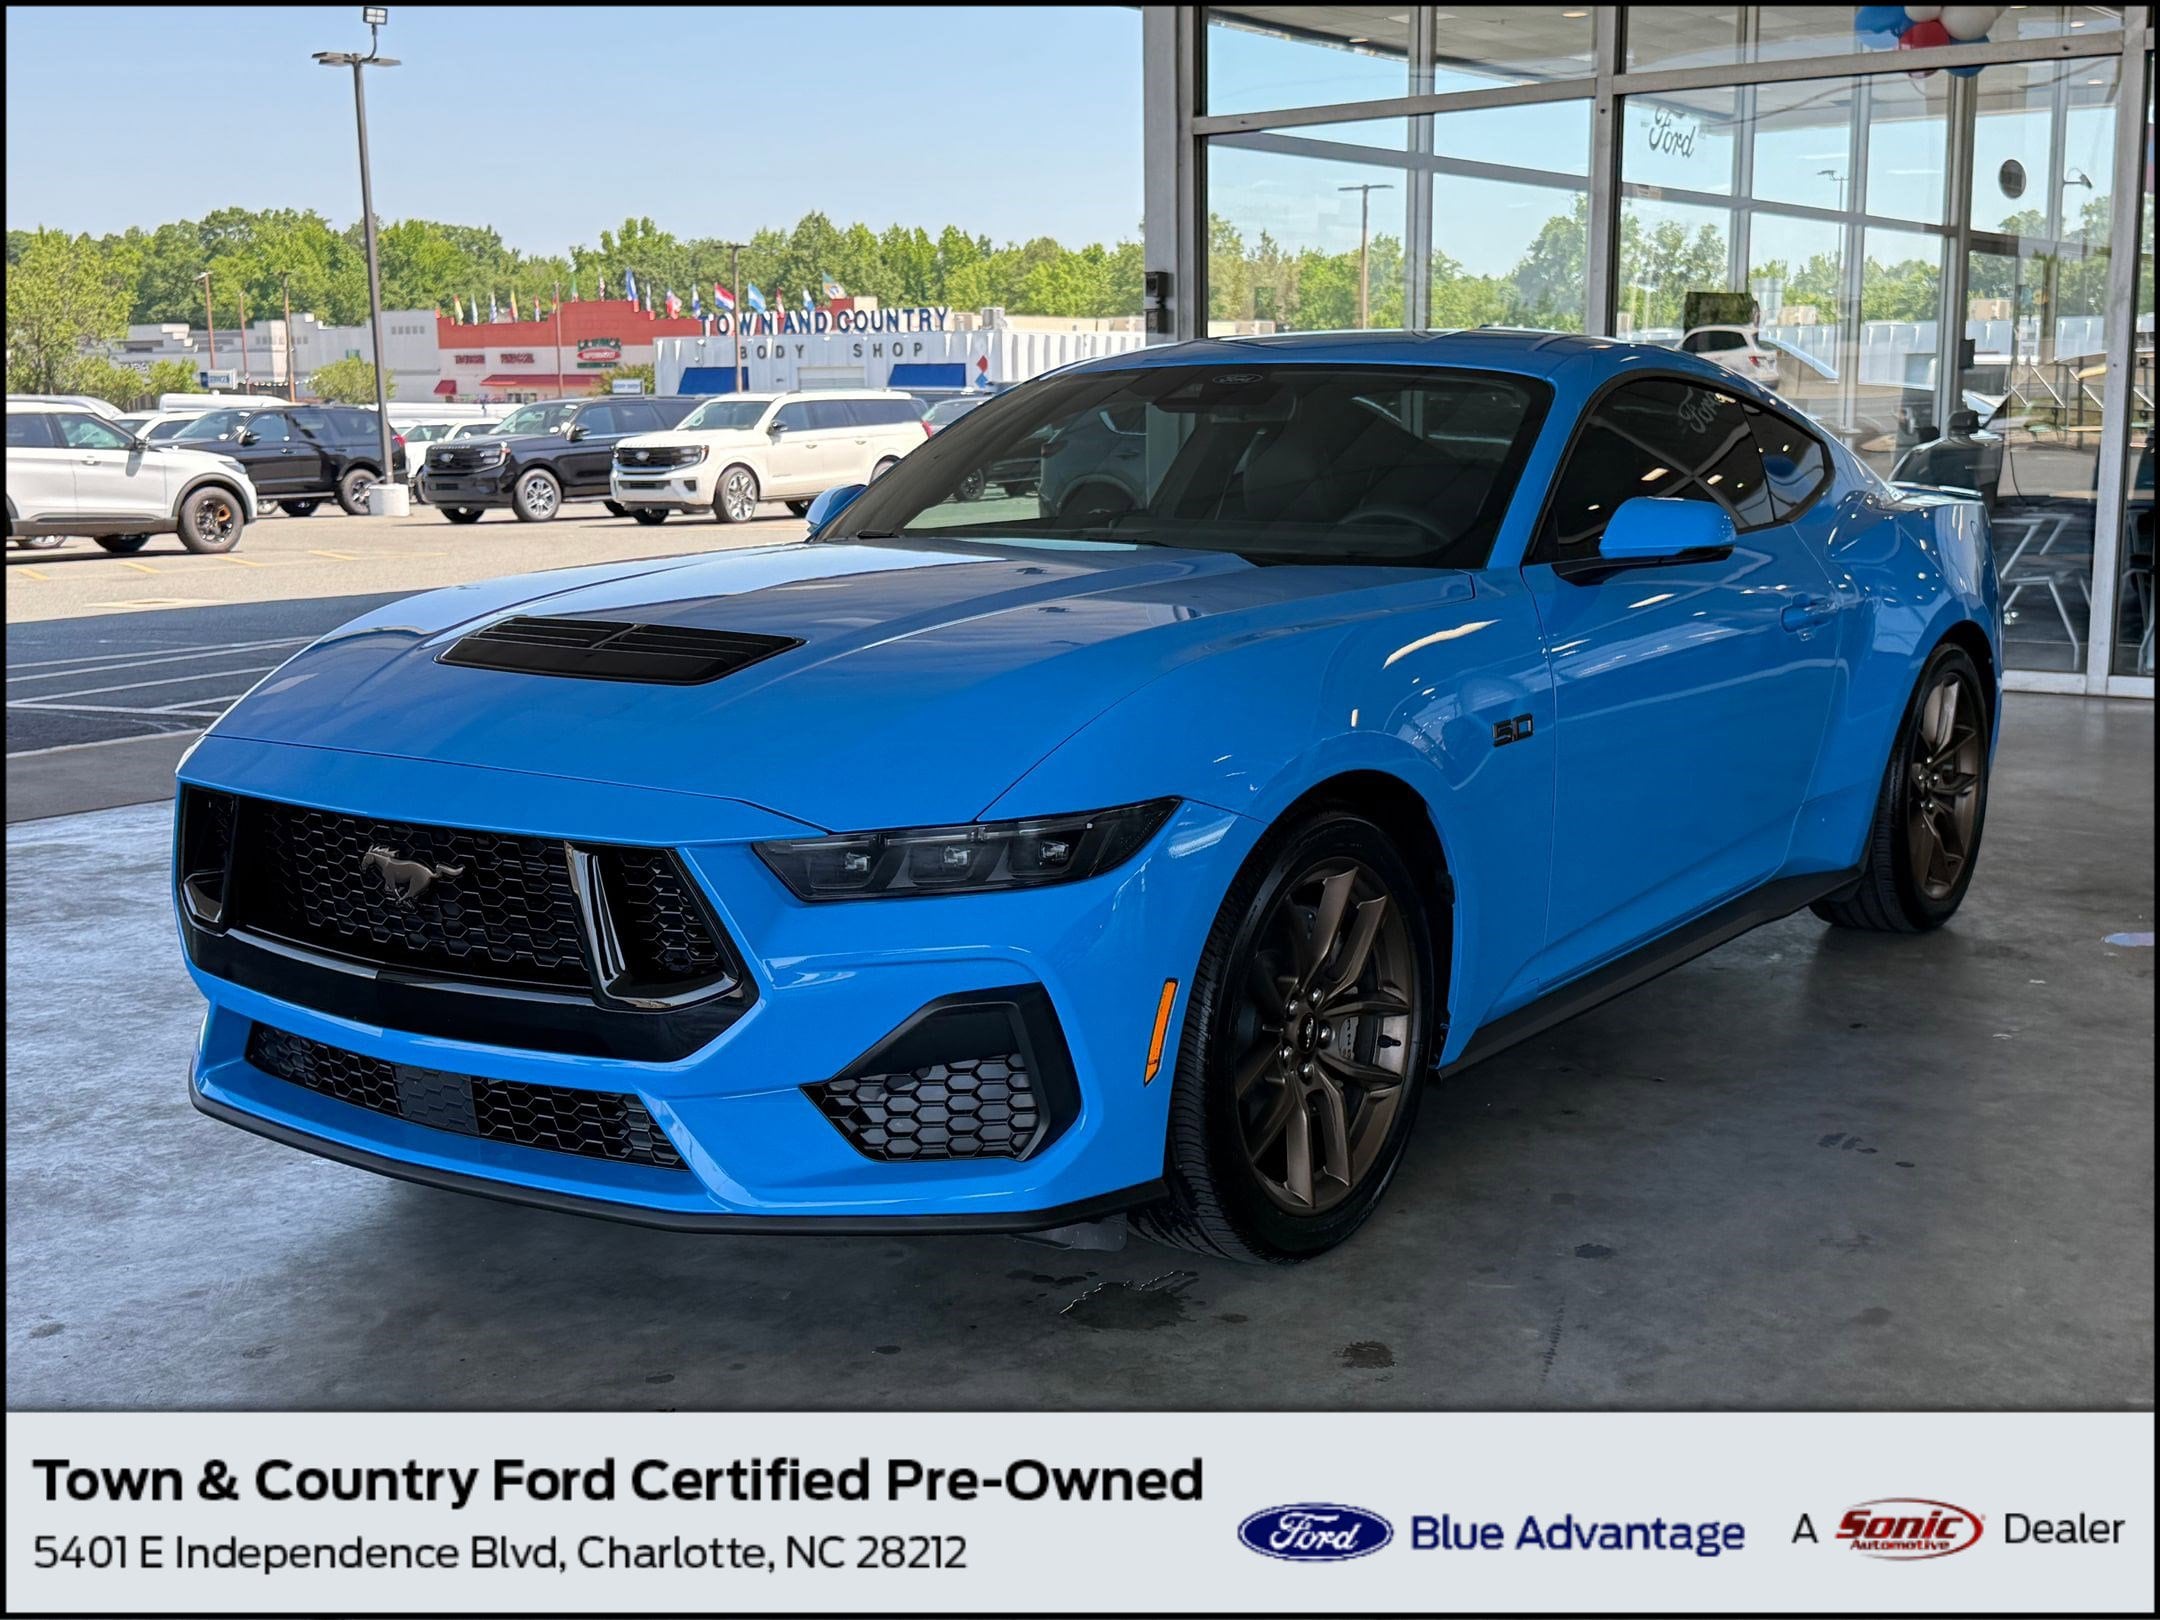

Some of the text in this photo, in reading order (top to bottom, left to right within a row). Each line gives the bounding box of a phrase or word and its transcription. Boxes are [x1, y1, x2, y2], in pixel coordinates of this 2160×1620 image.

[1649, 106, 1696, 159] Ford
[698, 306, 953, 337] TOWN AND COUNTRY
[739, 341, 924, 360] BODY SHOP
